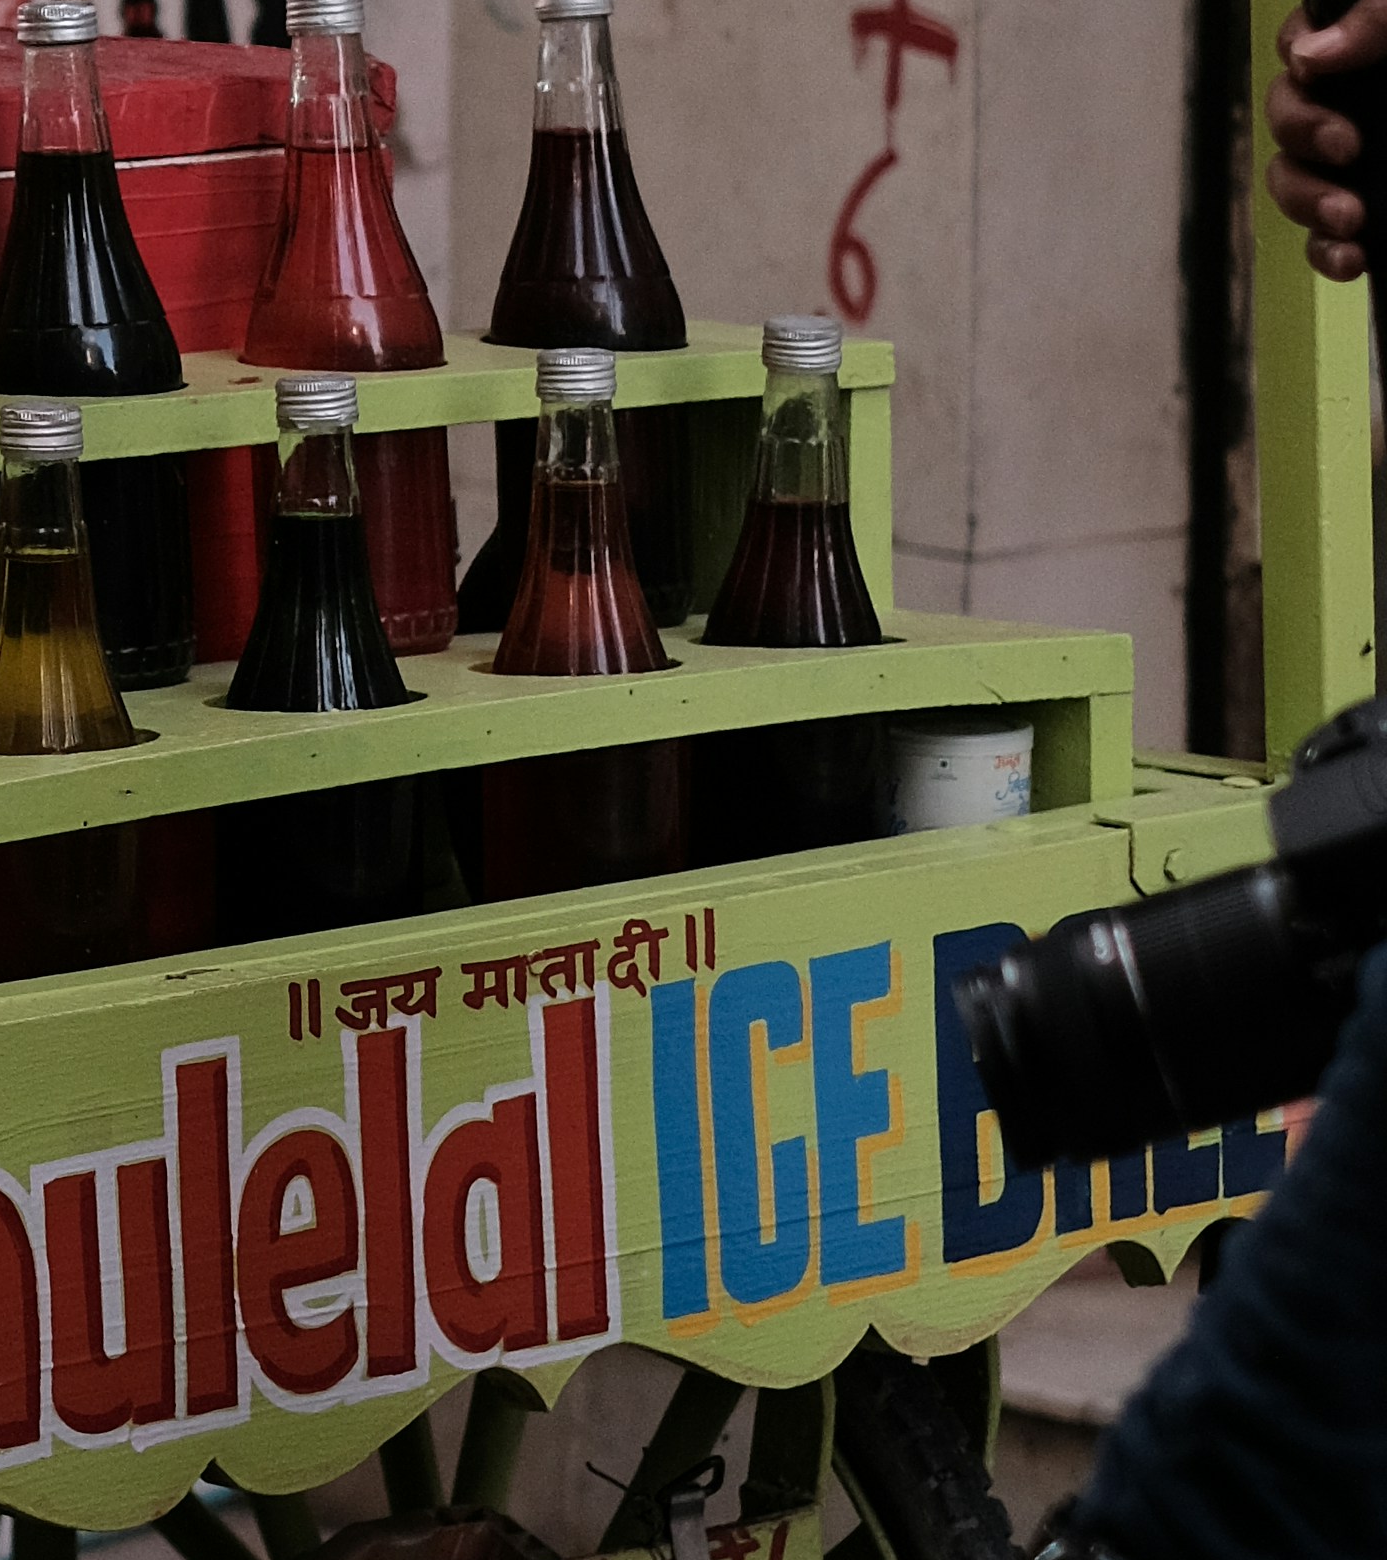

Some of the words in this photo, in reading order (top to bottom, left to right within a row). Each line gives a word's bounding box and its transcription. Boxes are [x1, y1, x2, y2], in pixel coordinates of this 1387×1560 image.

[335, 965, 443, 1031] जय
[461, 938, 601, 1010] माता
[608, 918, 669, 998] दी
[650, 938, 908, 1321] ICE
